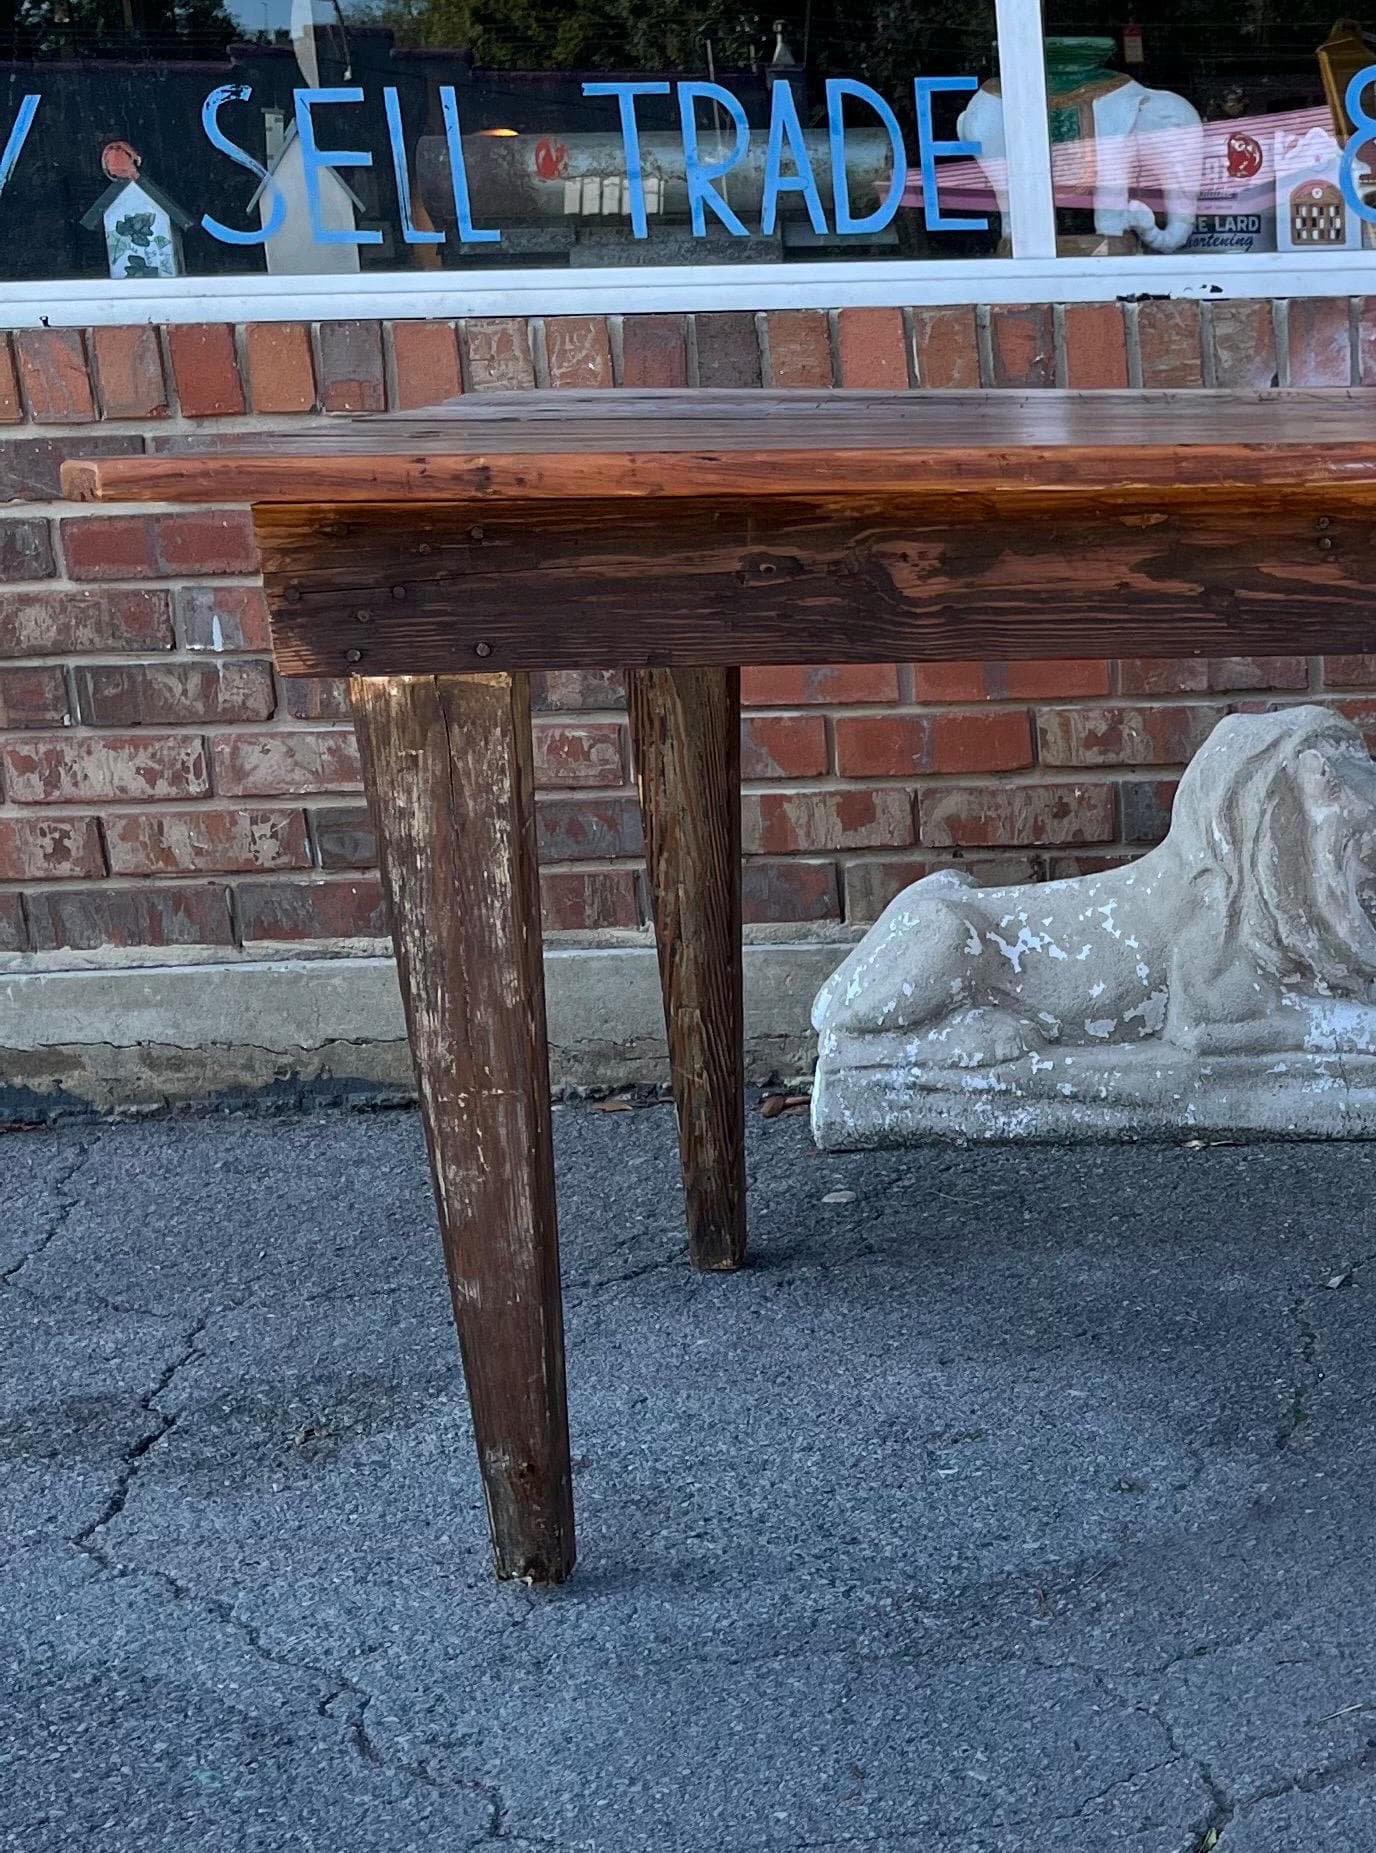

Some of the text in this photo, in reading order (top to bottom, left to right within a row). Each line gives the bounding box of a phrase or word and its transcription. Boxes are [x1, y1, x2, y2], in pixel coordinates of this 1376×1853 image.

[201, 84, 501, 246] SELL
[582, 76, 990, 239] TRADE
[1214, 216, 1259, 232] LARD
